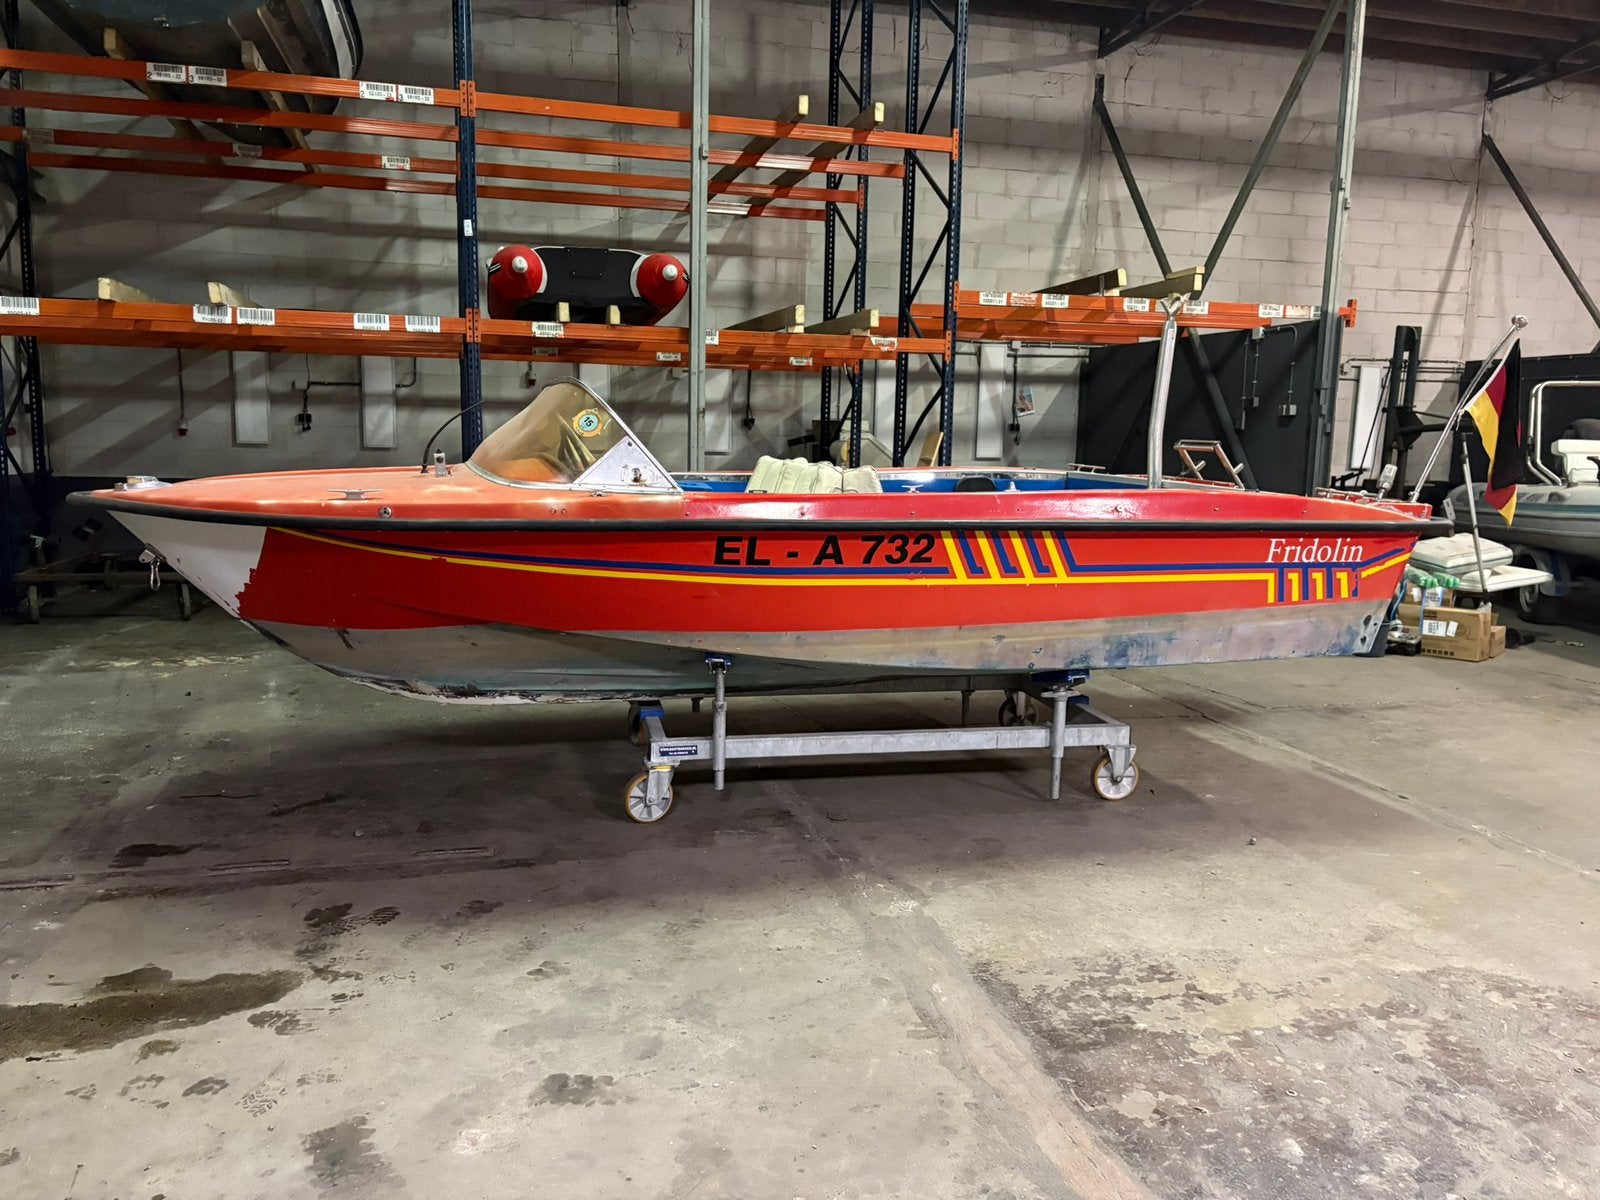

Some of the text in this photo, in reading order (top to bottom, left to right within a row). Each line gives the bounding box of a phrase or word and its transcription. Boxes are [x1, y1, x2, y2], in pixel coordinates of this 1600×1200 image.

[147, 72, 153, 80] 2
[189, 75, 195, 83] 3
[584, 416, 594, 427] 15
[714, 537, 770, 566] EL
[812, 535, 844, 565] A
[860, 534, 935, 564] 732
[1266, 537, 1364, 563] Fridolin
